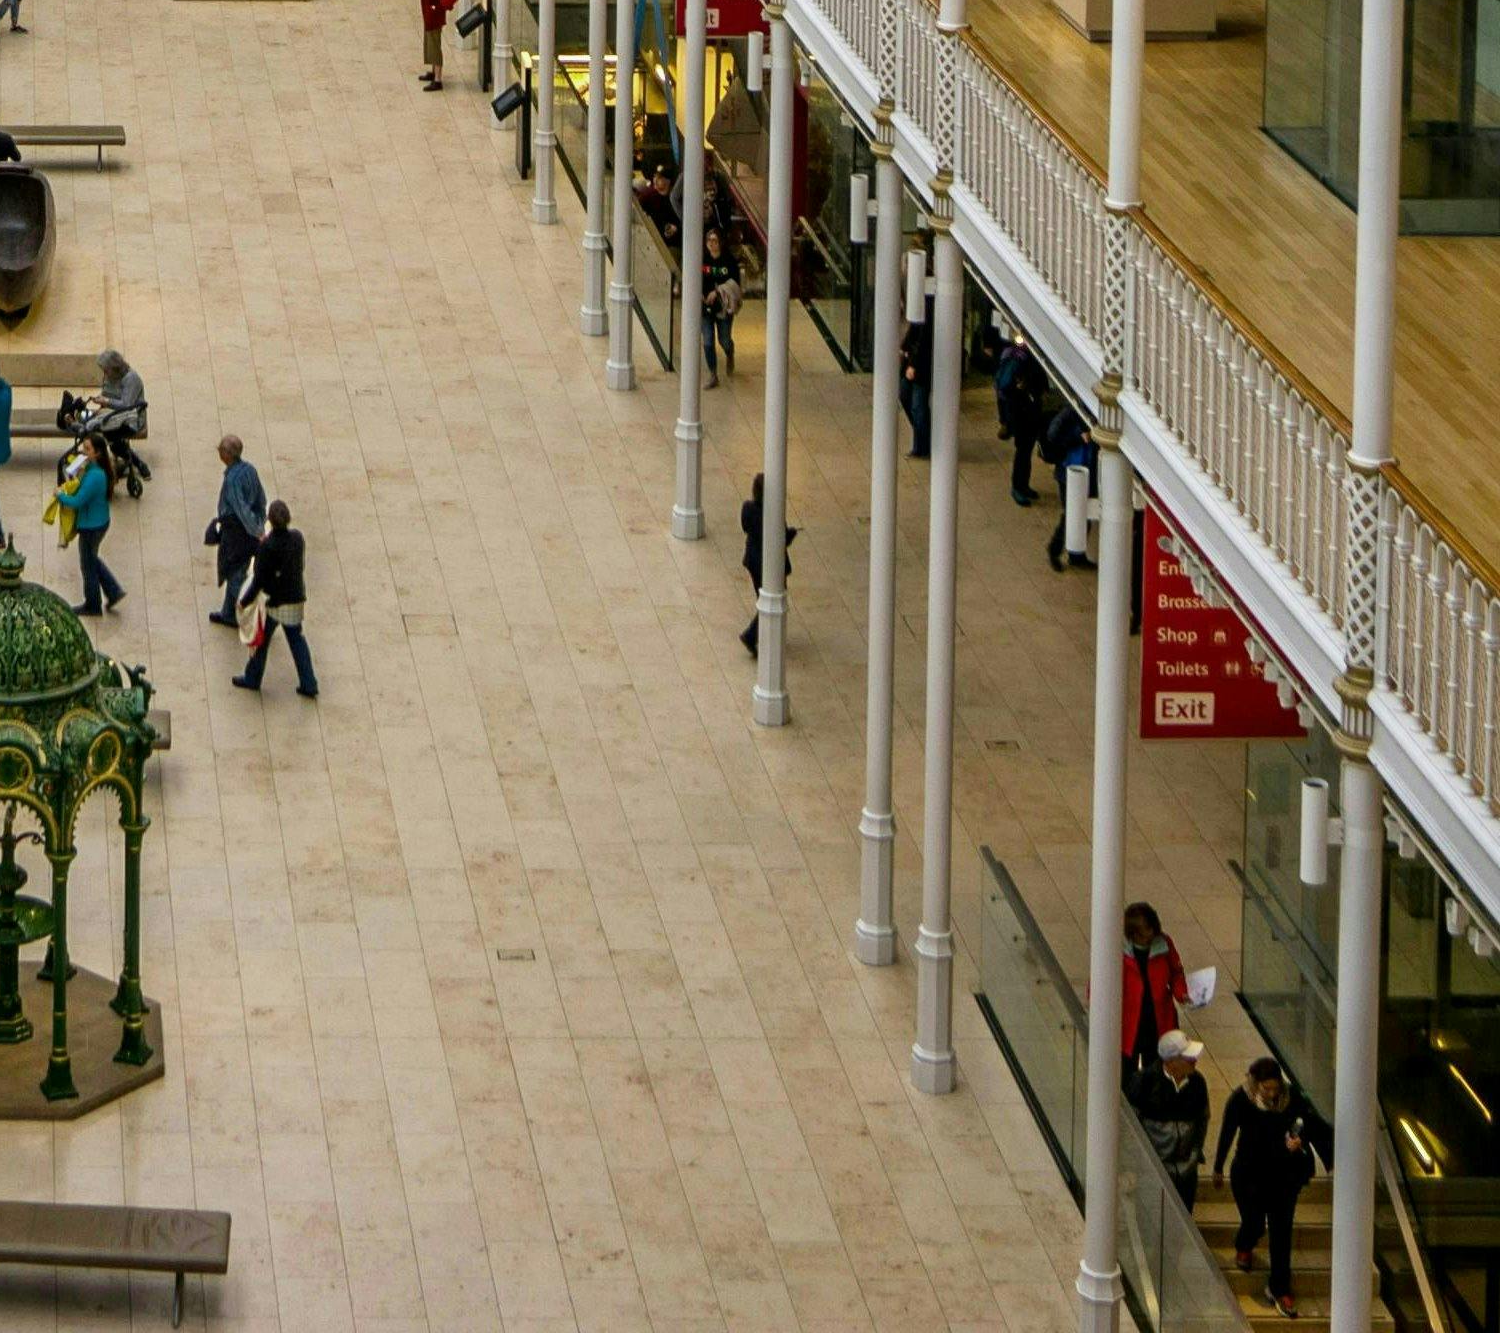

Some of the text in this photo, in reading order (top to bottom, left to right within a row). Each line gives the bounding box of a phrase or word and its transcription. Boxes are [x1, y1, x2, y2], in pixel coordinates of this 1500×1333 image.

[1157, 628, 1197, 645] Shop
[1157, 661, 1209, 676] Toilets
[1162, 698, 1207, 719] Exit
